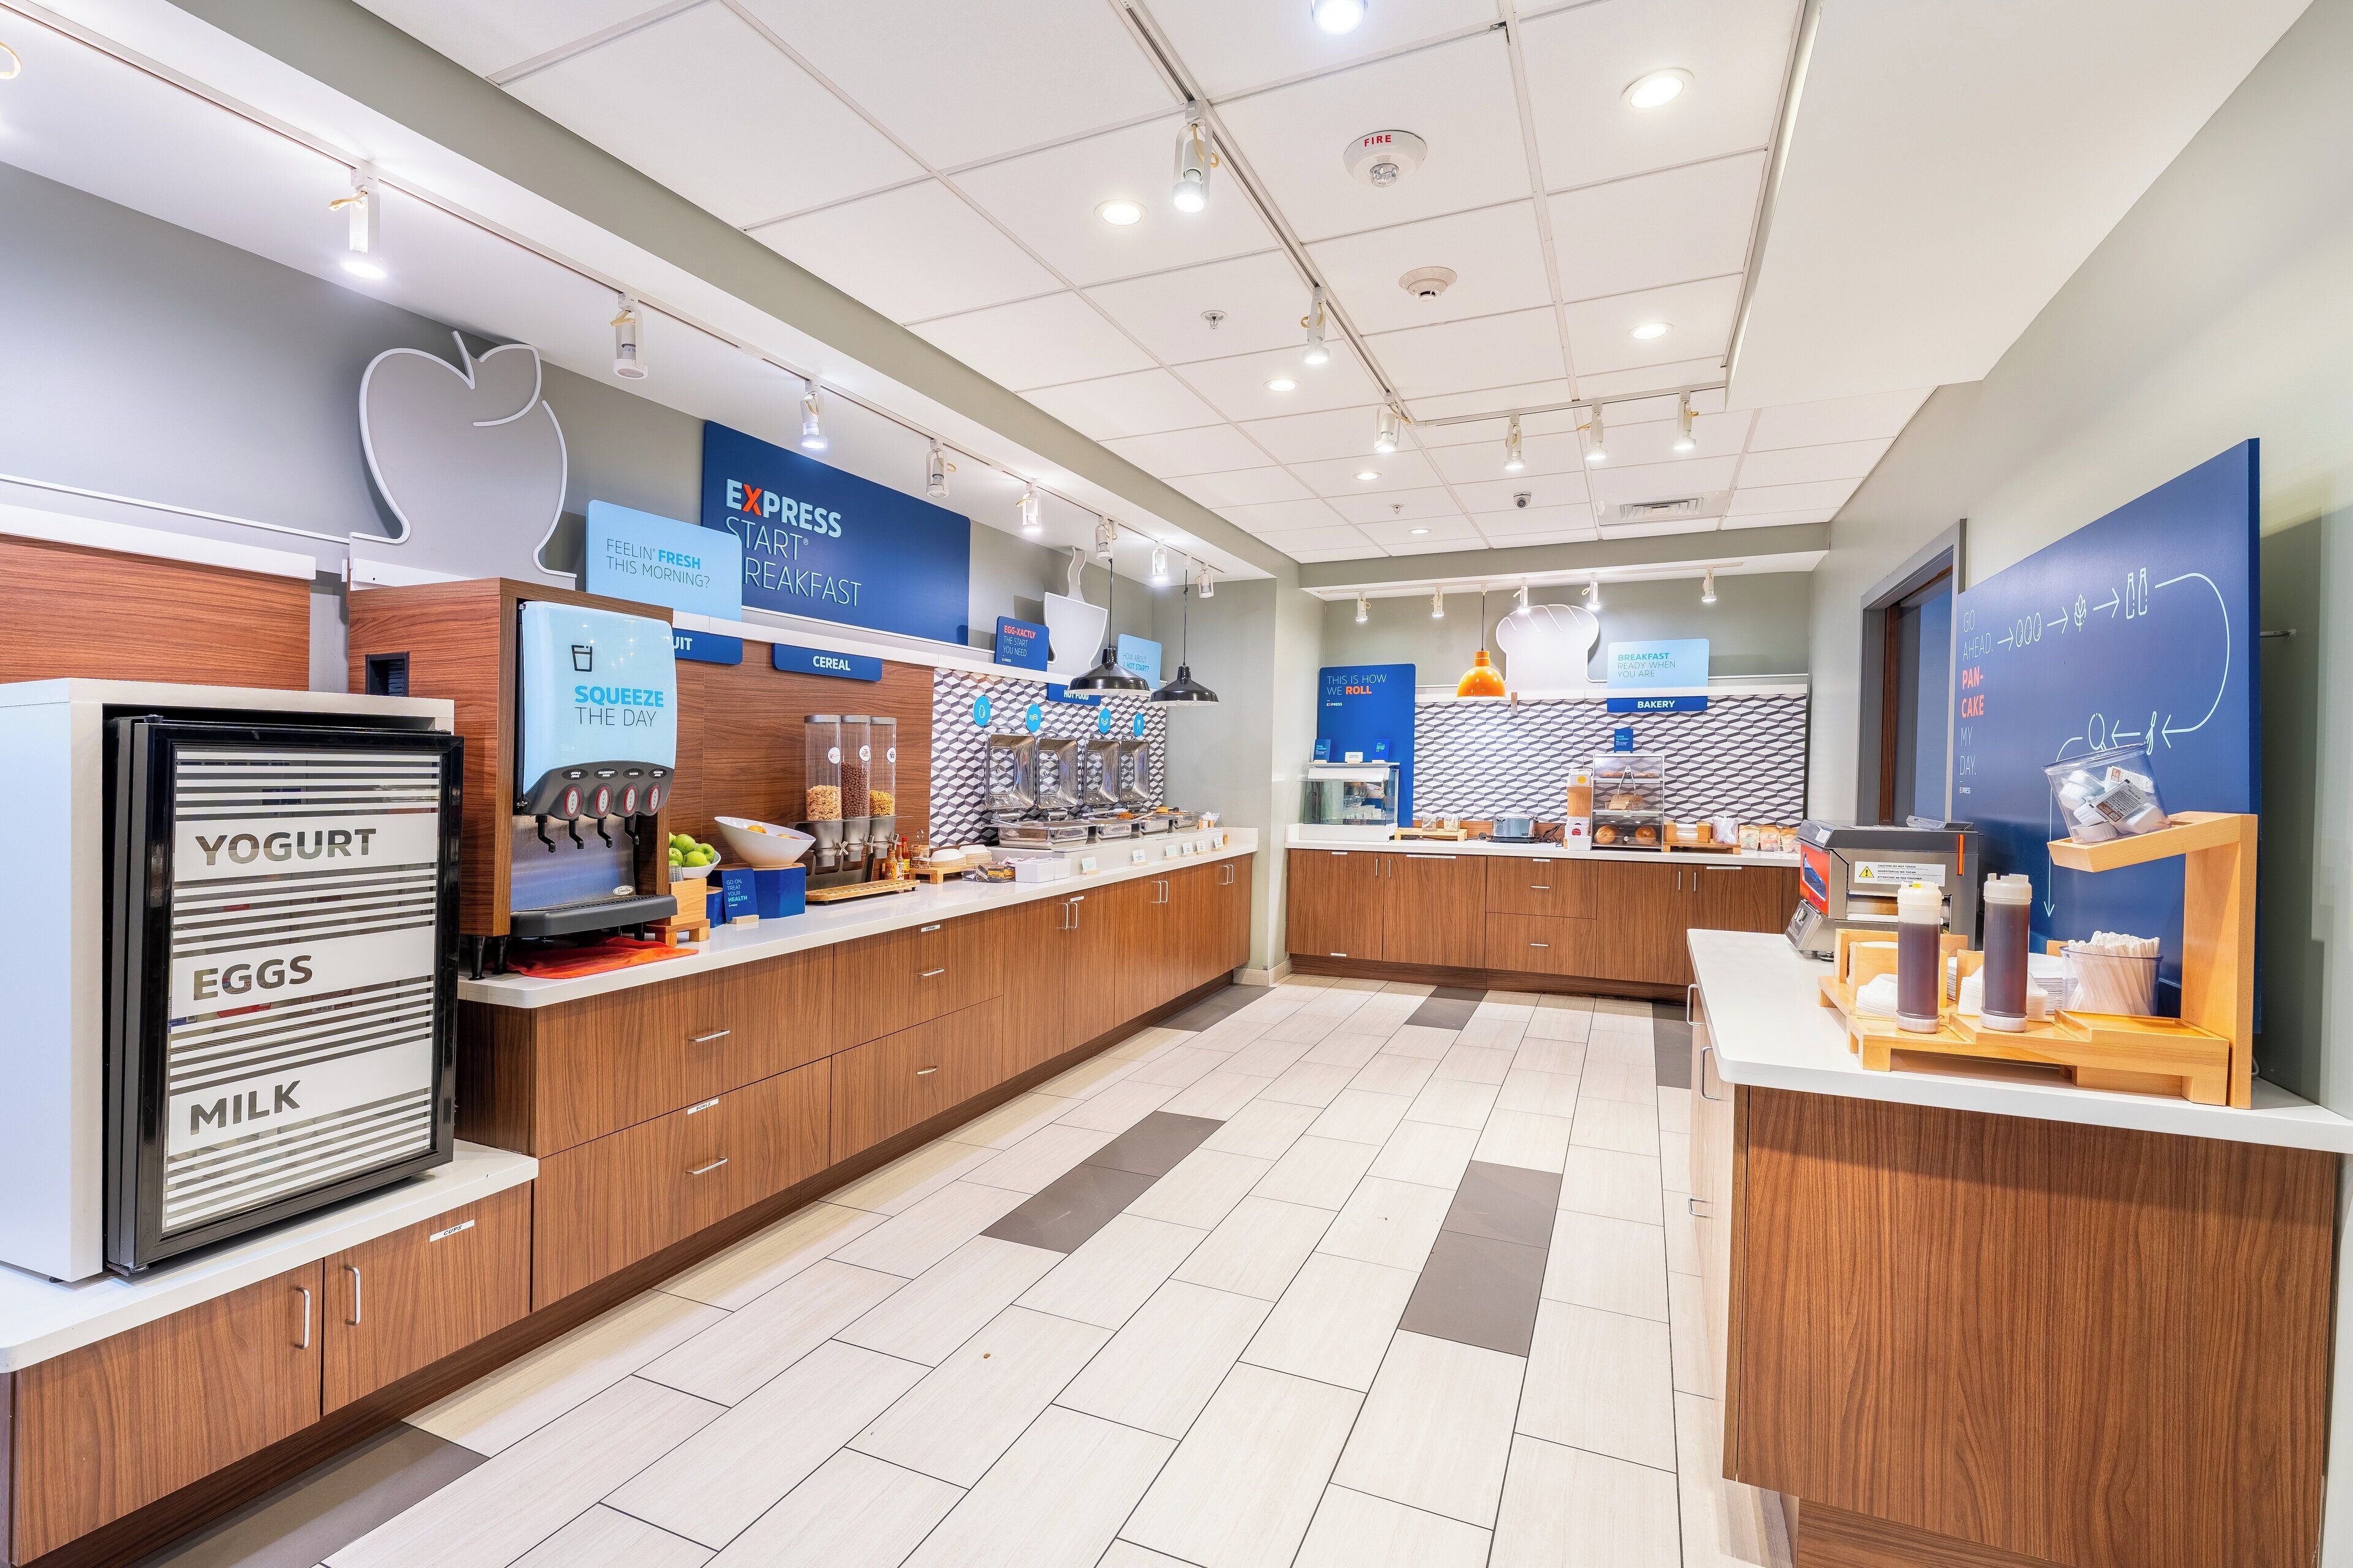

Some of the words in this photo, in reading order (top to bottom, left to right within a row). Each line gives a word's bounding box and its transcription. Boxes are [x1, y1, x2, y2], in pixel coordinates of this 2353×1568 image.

[1364, 135, 1392, 147] FIRE
[726, 479, 842, 538] EXPRESS
[607, 538, 655, 561] FEELIN'
[659, 550, 700, 570] FRESH
[607, 556, 637, 574] THIS
[642, 563, 710, 588] MORNING?
[743, 556, 862, 607] REAKFAST
[1963, 610, 1975, 632] GO
[1004, 625, 1036, 639] EGG-XACTLY
[1004, 635, 1014, 645] THE
[1014, 638, 1028, 647] START
[672, 636, 692, 651] UIT
[1003, 645, 1014, 654] YOU
[1014, 648, 1027, 657] NEED
[1963, 632, 1993, 662] AHEAD.
[813, 655, 851, 672] CEREAL
[1123, 652, 1134, 661] HOW
[1134, 654, 1147, 663] ABOUT
[1618, 653, 1670, 661] BREAKFAST
[1135, 664, 1150, 673] START?
[1962, 665, 1984, 690] PAN-
[1327, 675, 1347, 685] THIS
[1351, 675, 1358, 684] IS
[1362, 674, 1387, 683] HOW
[574, 685, 664, 708] SQUEEZE
[1327, 686, 1343, 695] WE
[1346, 685, 1372, 695] ROLL
[1961, 694, 1984, 719] CAKE
[575, 706, 615, 725] THE
[624, 709, 657, 727] DAY
[1961, 726, 1973, 746] MY
[1960, 756, 1976, 775] DAY.
[195, 827, 377, 866] YOGURT
[193, 955, 313, 1001] EGGS
[190, 1080, 301, 1137] MILK
[695, 1102, 711, 1111] BOWLS
[444, 1225, 463, 1236] CUPS
